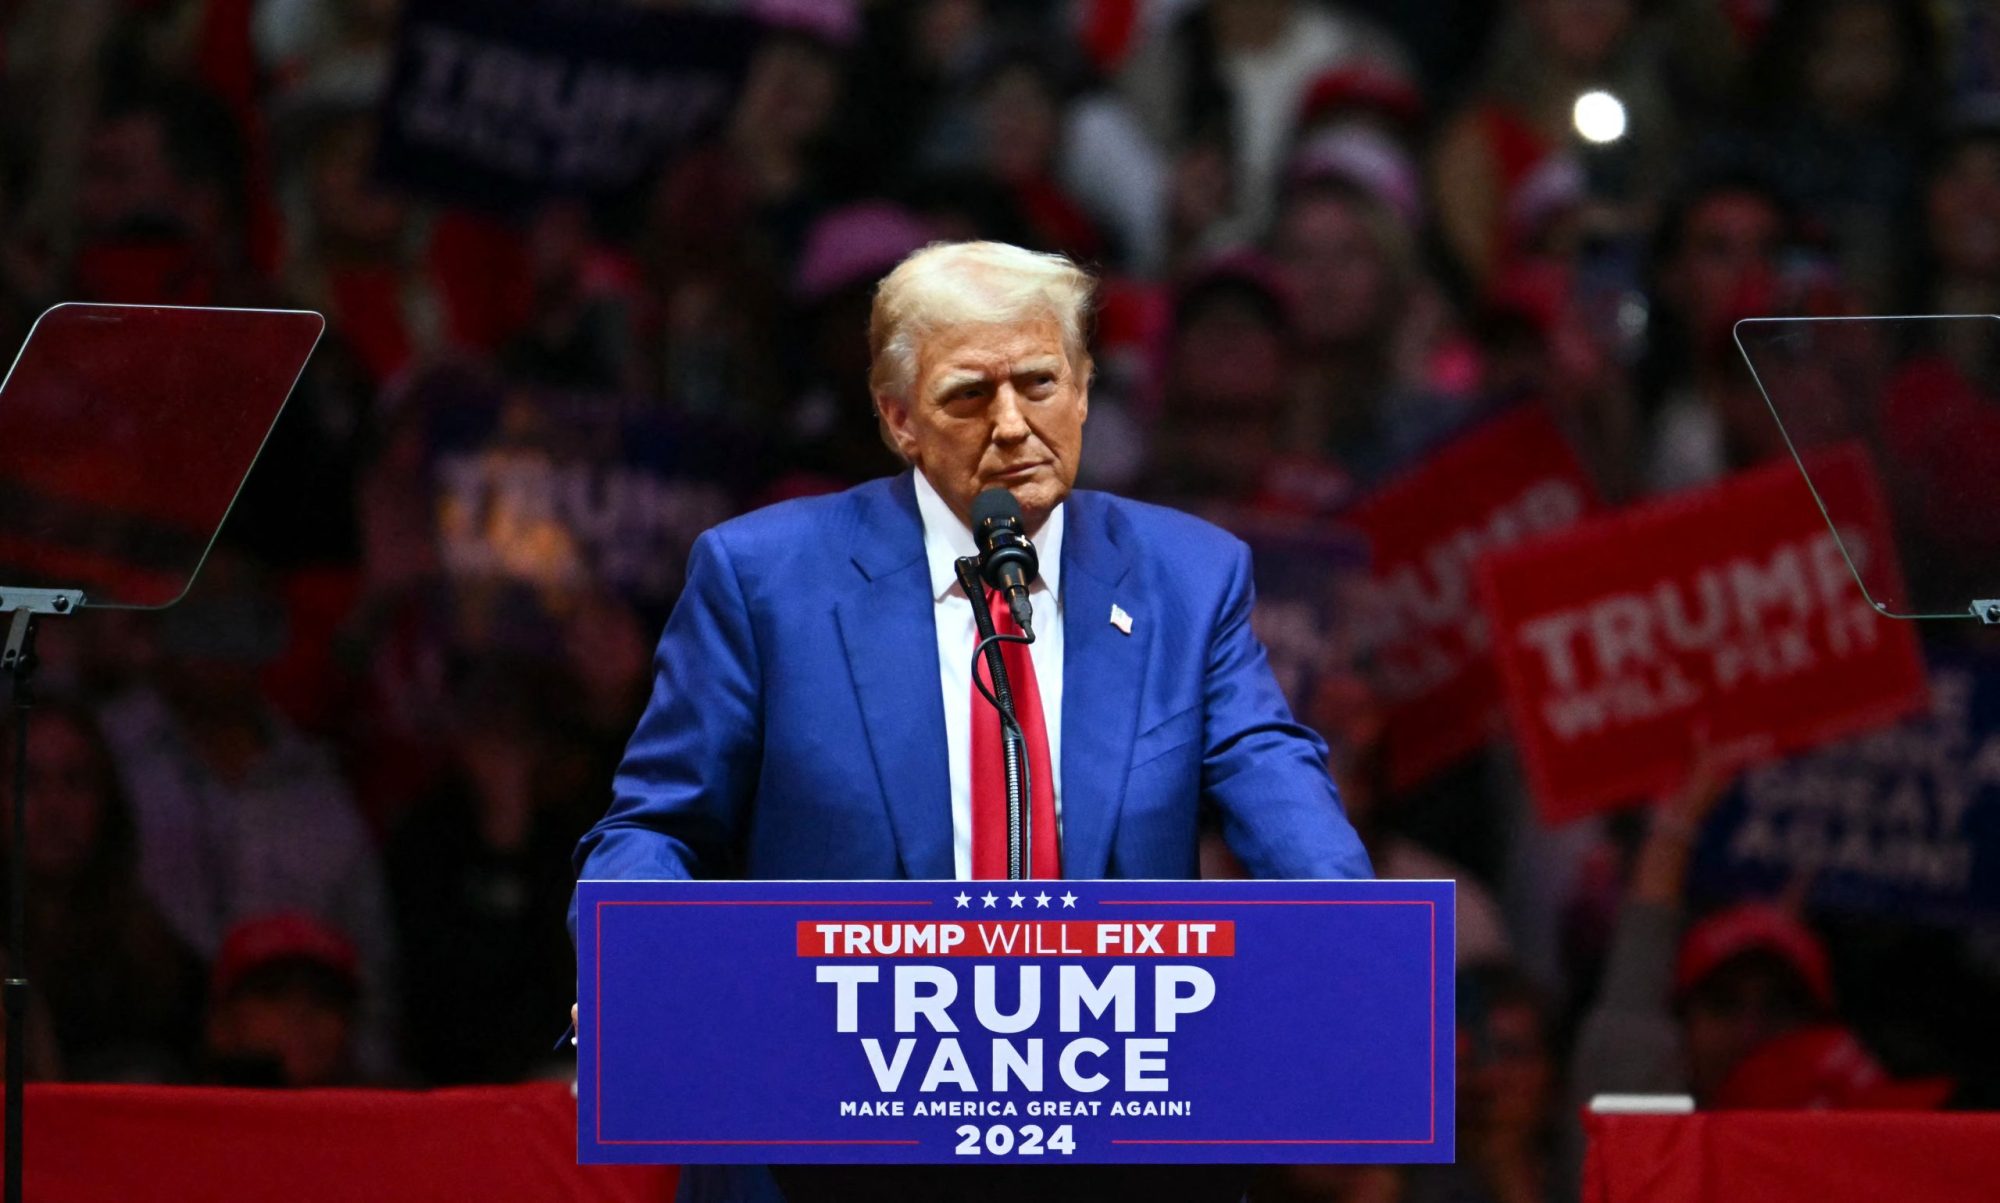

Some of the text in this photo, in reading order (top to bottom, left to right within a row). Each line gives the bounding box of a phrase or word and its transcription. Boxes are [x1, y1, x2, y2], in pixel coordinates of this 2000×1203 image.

[1514, 523, 1868, 692] TRUMP
[1541, 600, 1881, 743] WILL FIX IT
[816, 923, 1215, 954] TRUMP WILL FIX IT
[816, 965, 1215, 1033] TRUMP
[860, 1037, 1169, 1092] VANCE
[840, 1100, 1190, 1116] MAKE AMERICA GREAT AGAIN!
[955, 1124, 1075, 1155] 2024
